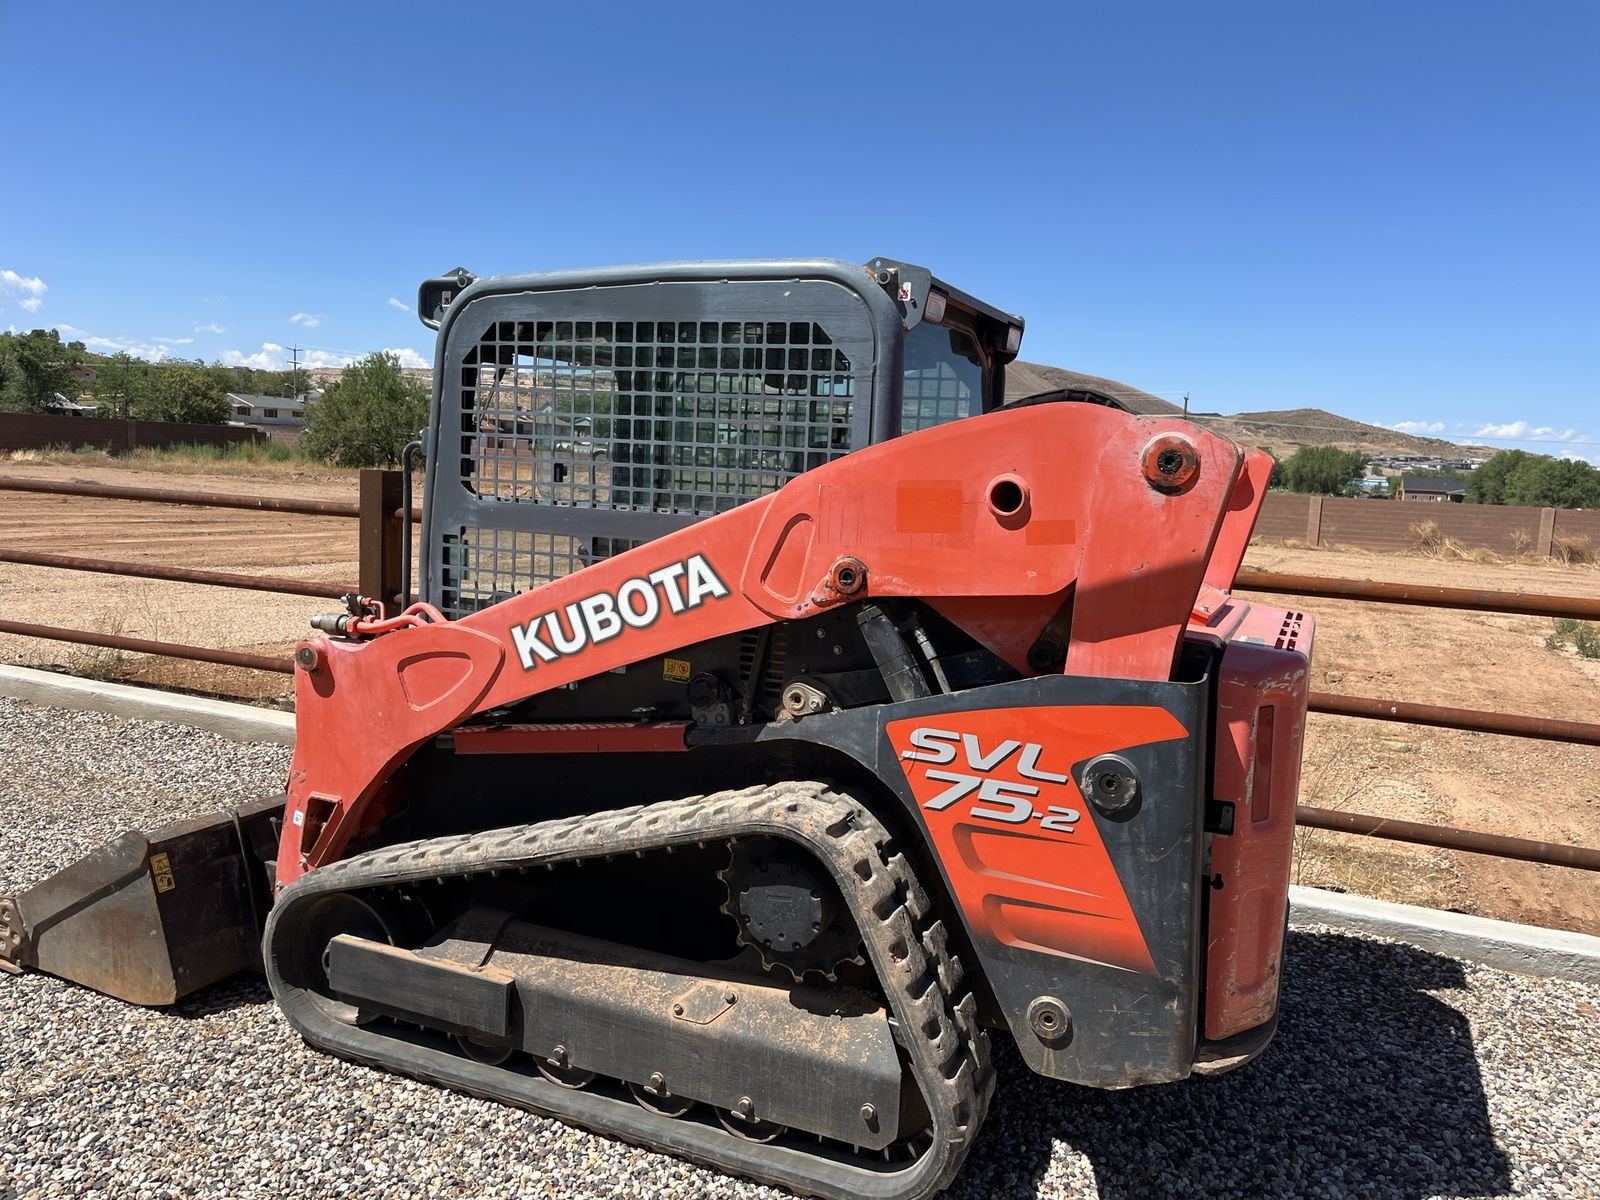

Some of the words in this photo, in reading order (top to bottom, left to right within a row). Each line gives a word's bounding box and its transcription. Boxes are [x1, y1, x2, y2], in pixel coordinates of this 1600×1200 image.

[510, 554, 729, 671] KUBOTA
[901, 727, 1068, 783] SVL
[922, 768, 1081, 834] 75-2
